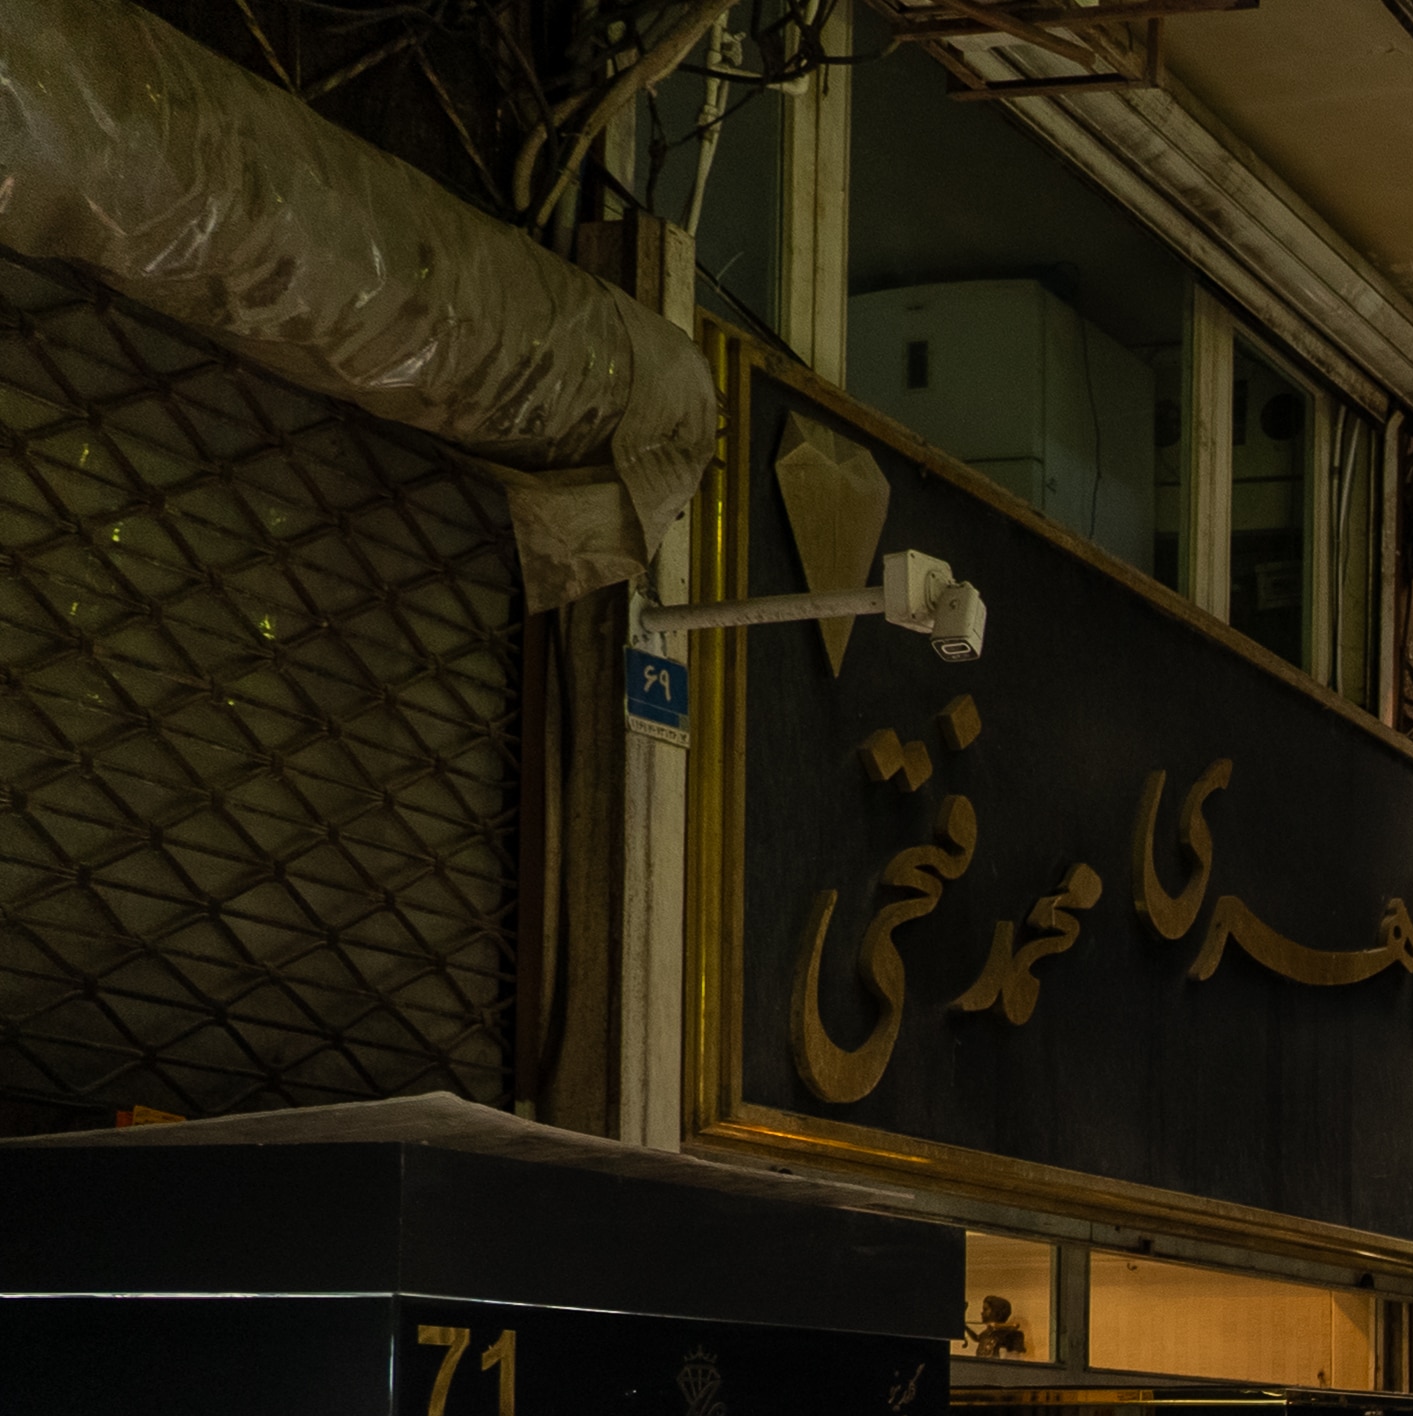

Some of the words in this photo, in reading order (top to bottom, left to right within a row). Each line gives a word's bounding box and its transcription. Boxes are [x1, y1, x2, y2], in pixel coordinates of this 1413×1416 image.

[643, 664, 672, 703] ۶۹
[791, 693, 982, 1105] فتحی
[952, 862, 1103, 1027] محمد
